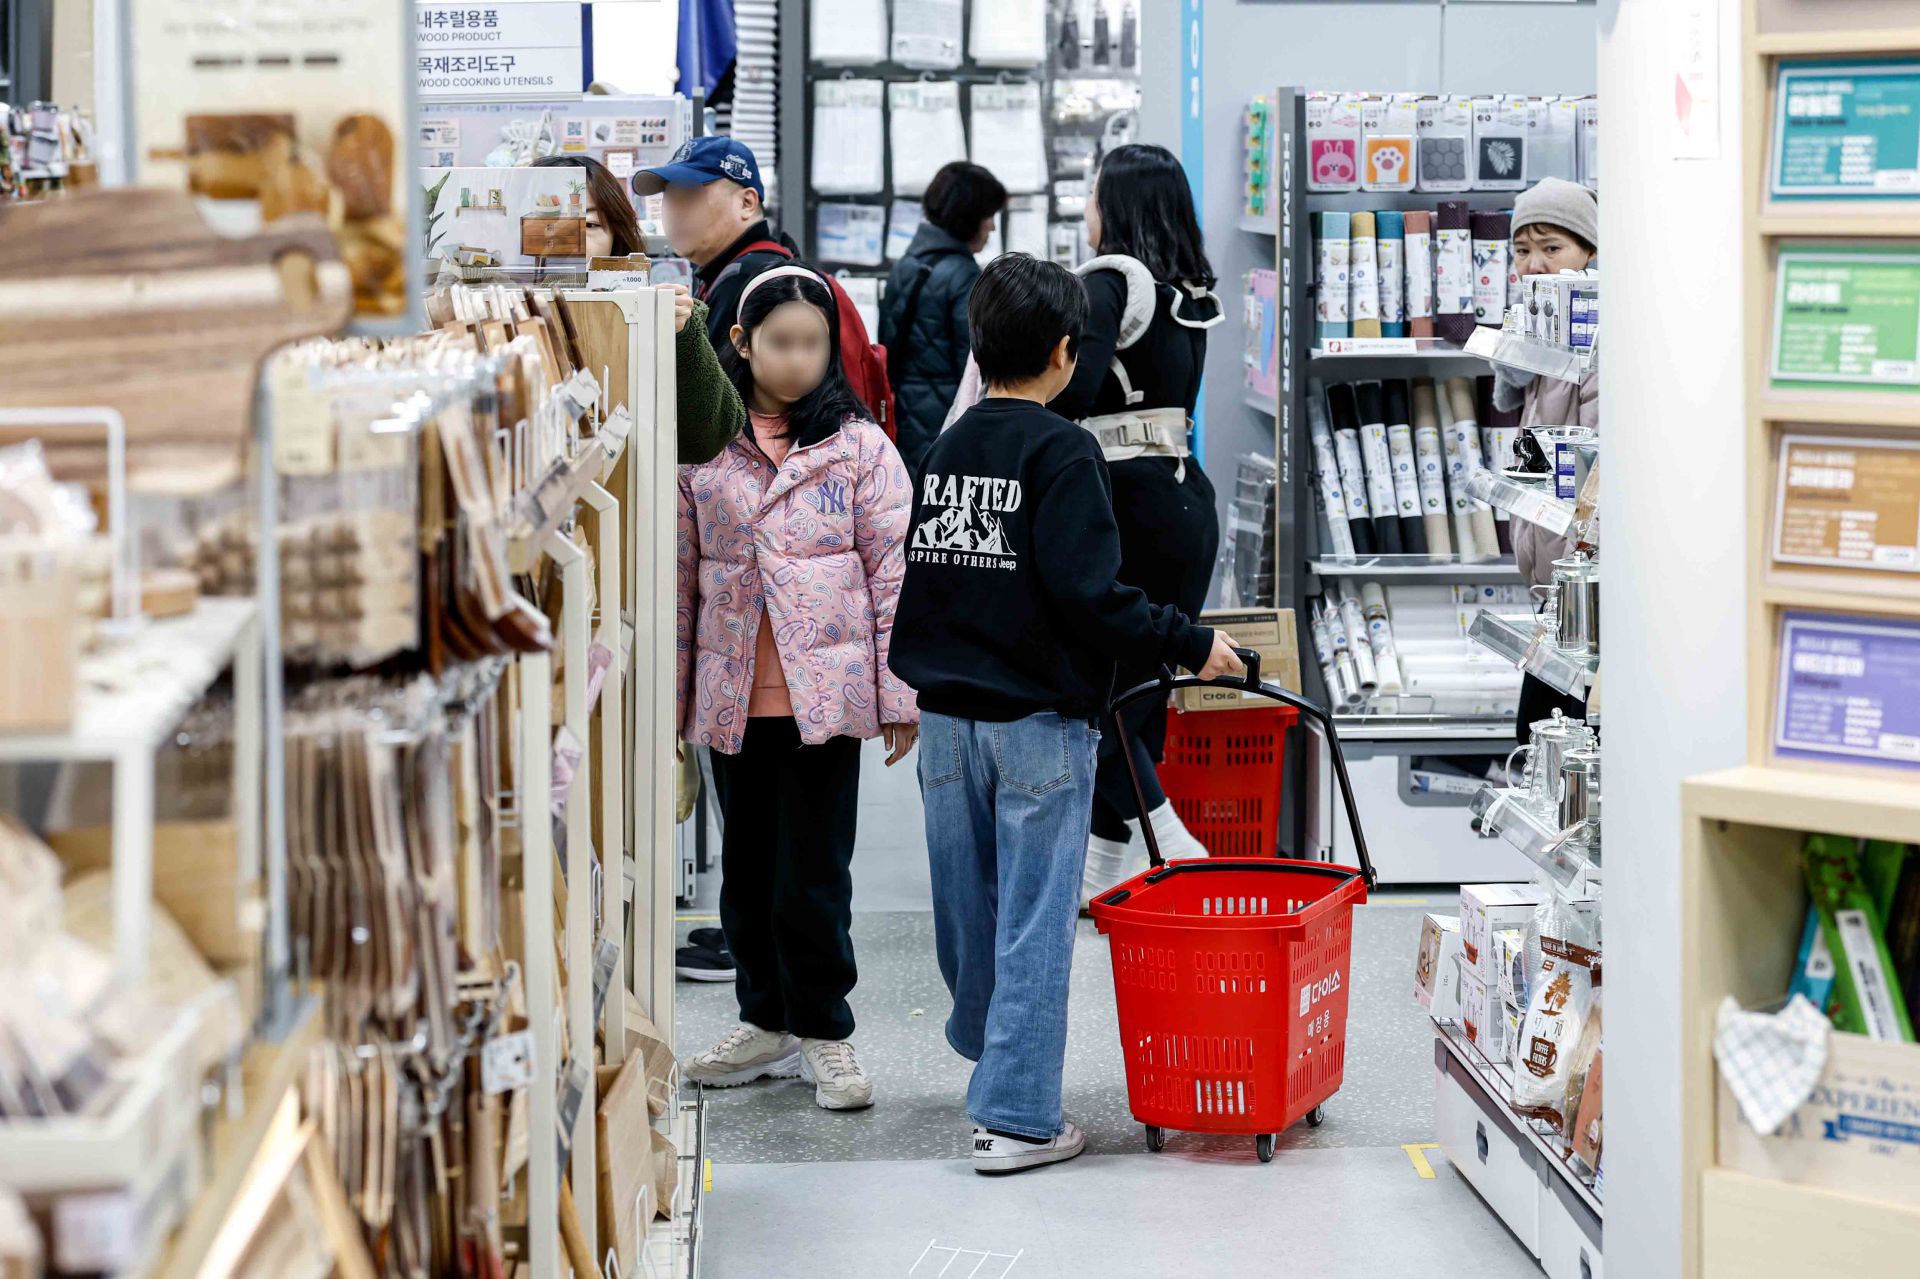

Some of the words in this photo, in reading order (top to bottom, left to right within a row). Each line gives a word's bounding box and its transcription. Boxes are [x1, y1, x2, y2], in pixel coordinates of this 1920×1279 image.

[416, 10, 499, 29] 내추럴용품
[416, 32, 450, 42] WOOD
[452, 31, 503, 41] PRODUCT
[417, 55, 517, 74] 목재조리도구
[417, 78, 450, 88] WOOD
[452, 77, 501, 87] COOKING
[503, 75, 554, 86] UTENSILS
[1282, 133, 1291, 249] HOME
[1282, 258, 1291, 392] DECOR
[817, 479, 846, 514] NY
[922, 473, 1022, 513] RAFTED
[908, 550, 948, 564] SPIRE
[953, 553, 998, 569] OTHERS
[998, 558, 1017, 571] Jeep
[1311, 968, 1341, 1005] 다이소
[974, 1138, 994, 1151] NIKE
